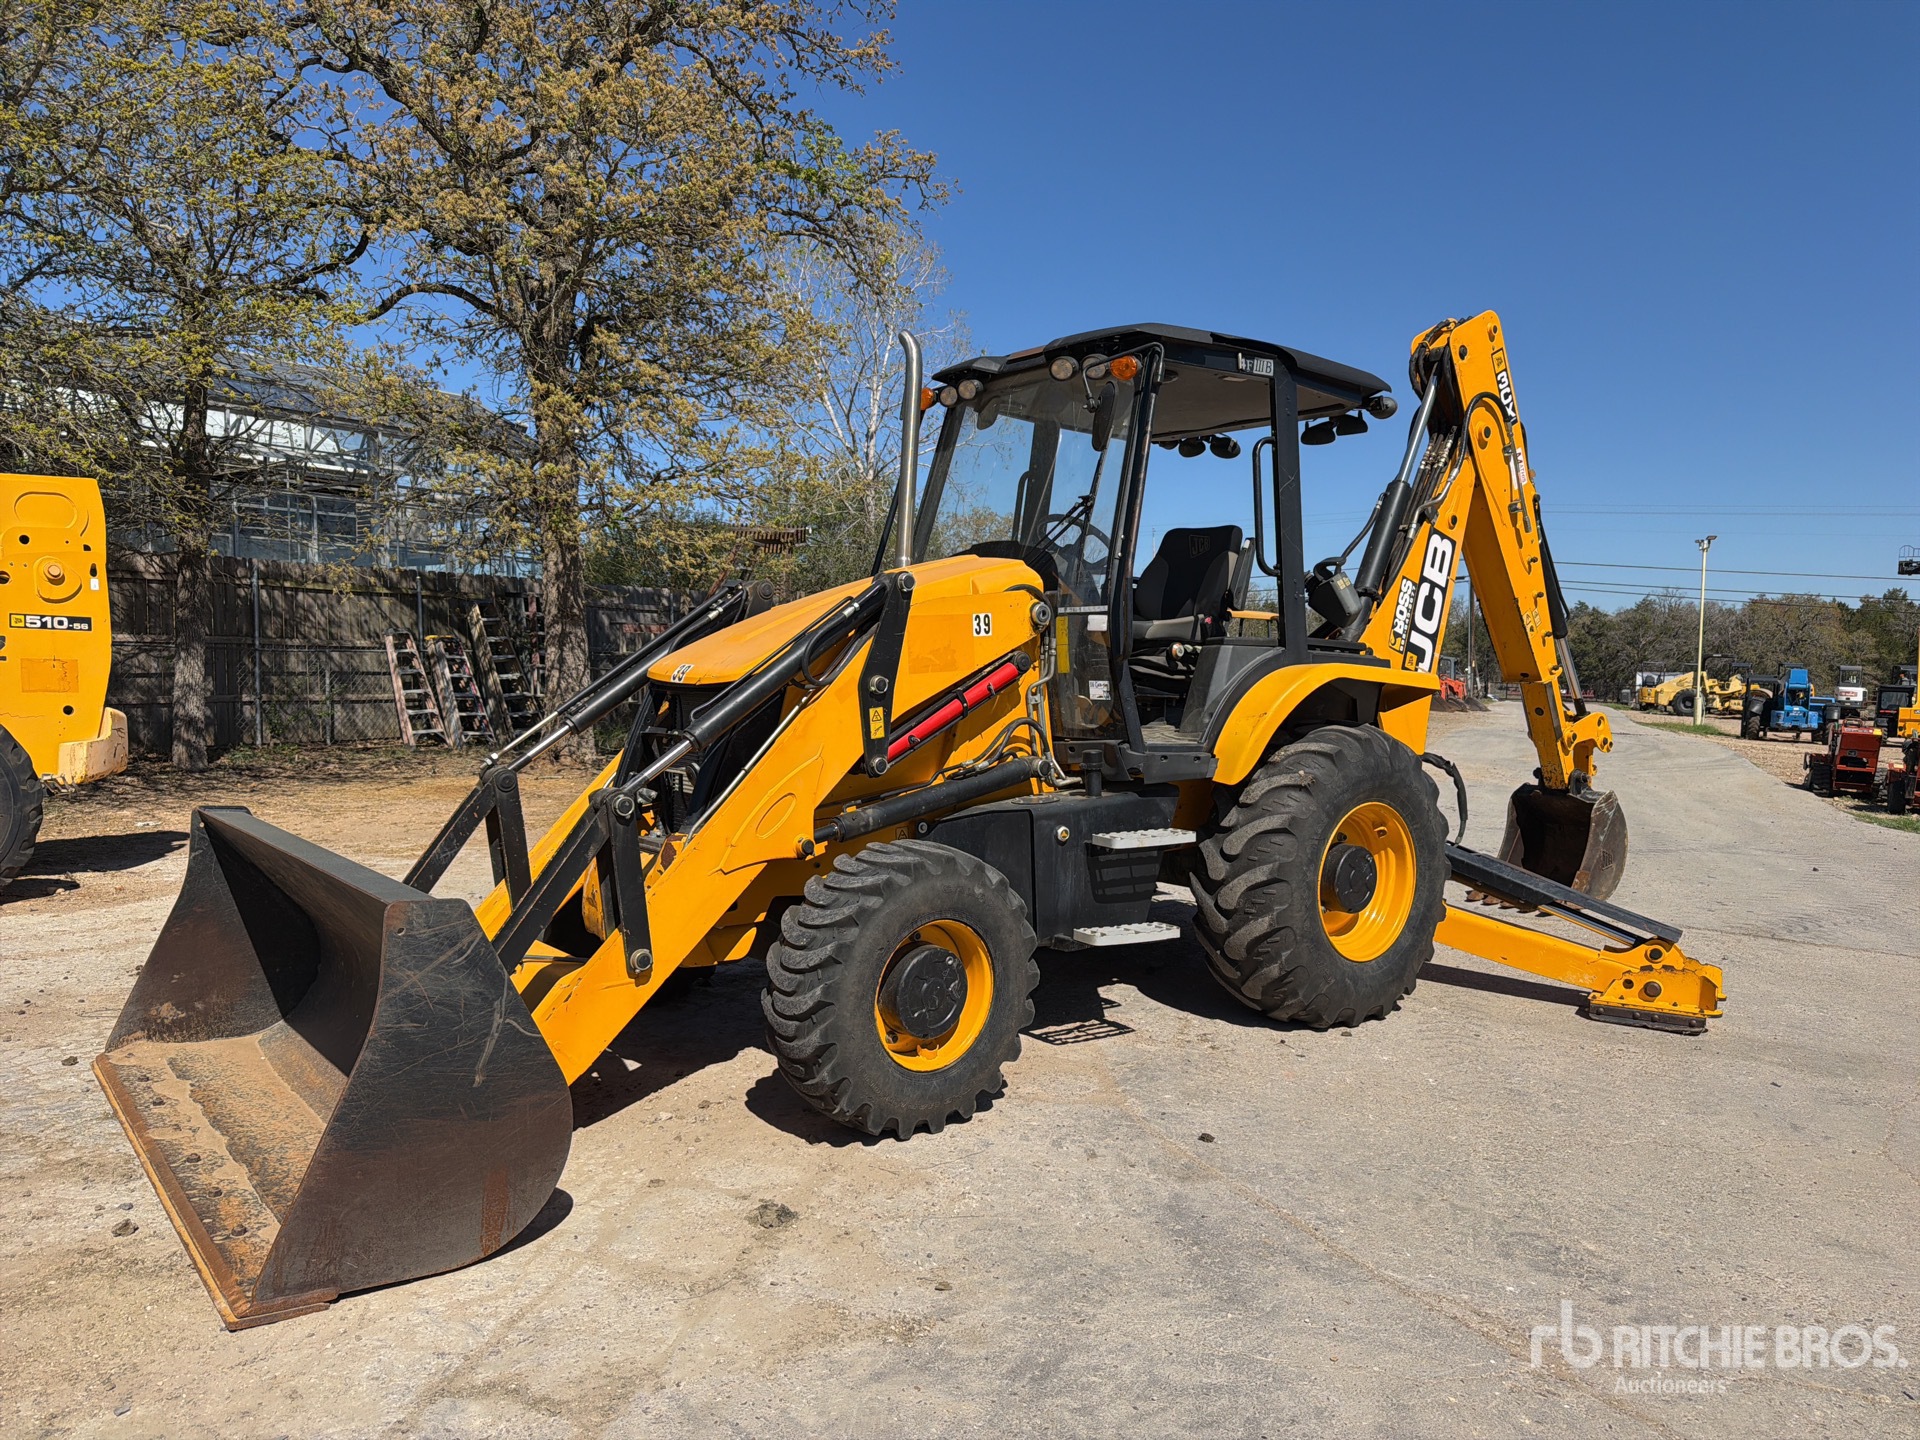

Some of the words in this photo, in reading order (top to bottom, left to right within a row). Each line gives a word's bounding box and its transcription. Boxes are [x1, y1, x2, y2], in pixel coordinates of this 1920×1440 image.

[1393, 578, 1413, 635] BOSS
[1410, 534, 1453, 673] JCB
[974, 614, 991, 635] 39
[672, 664, 692, 682] 39
